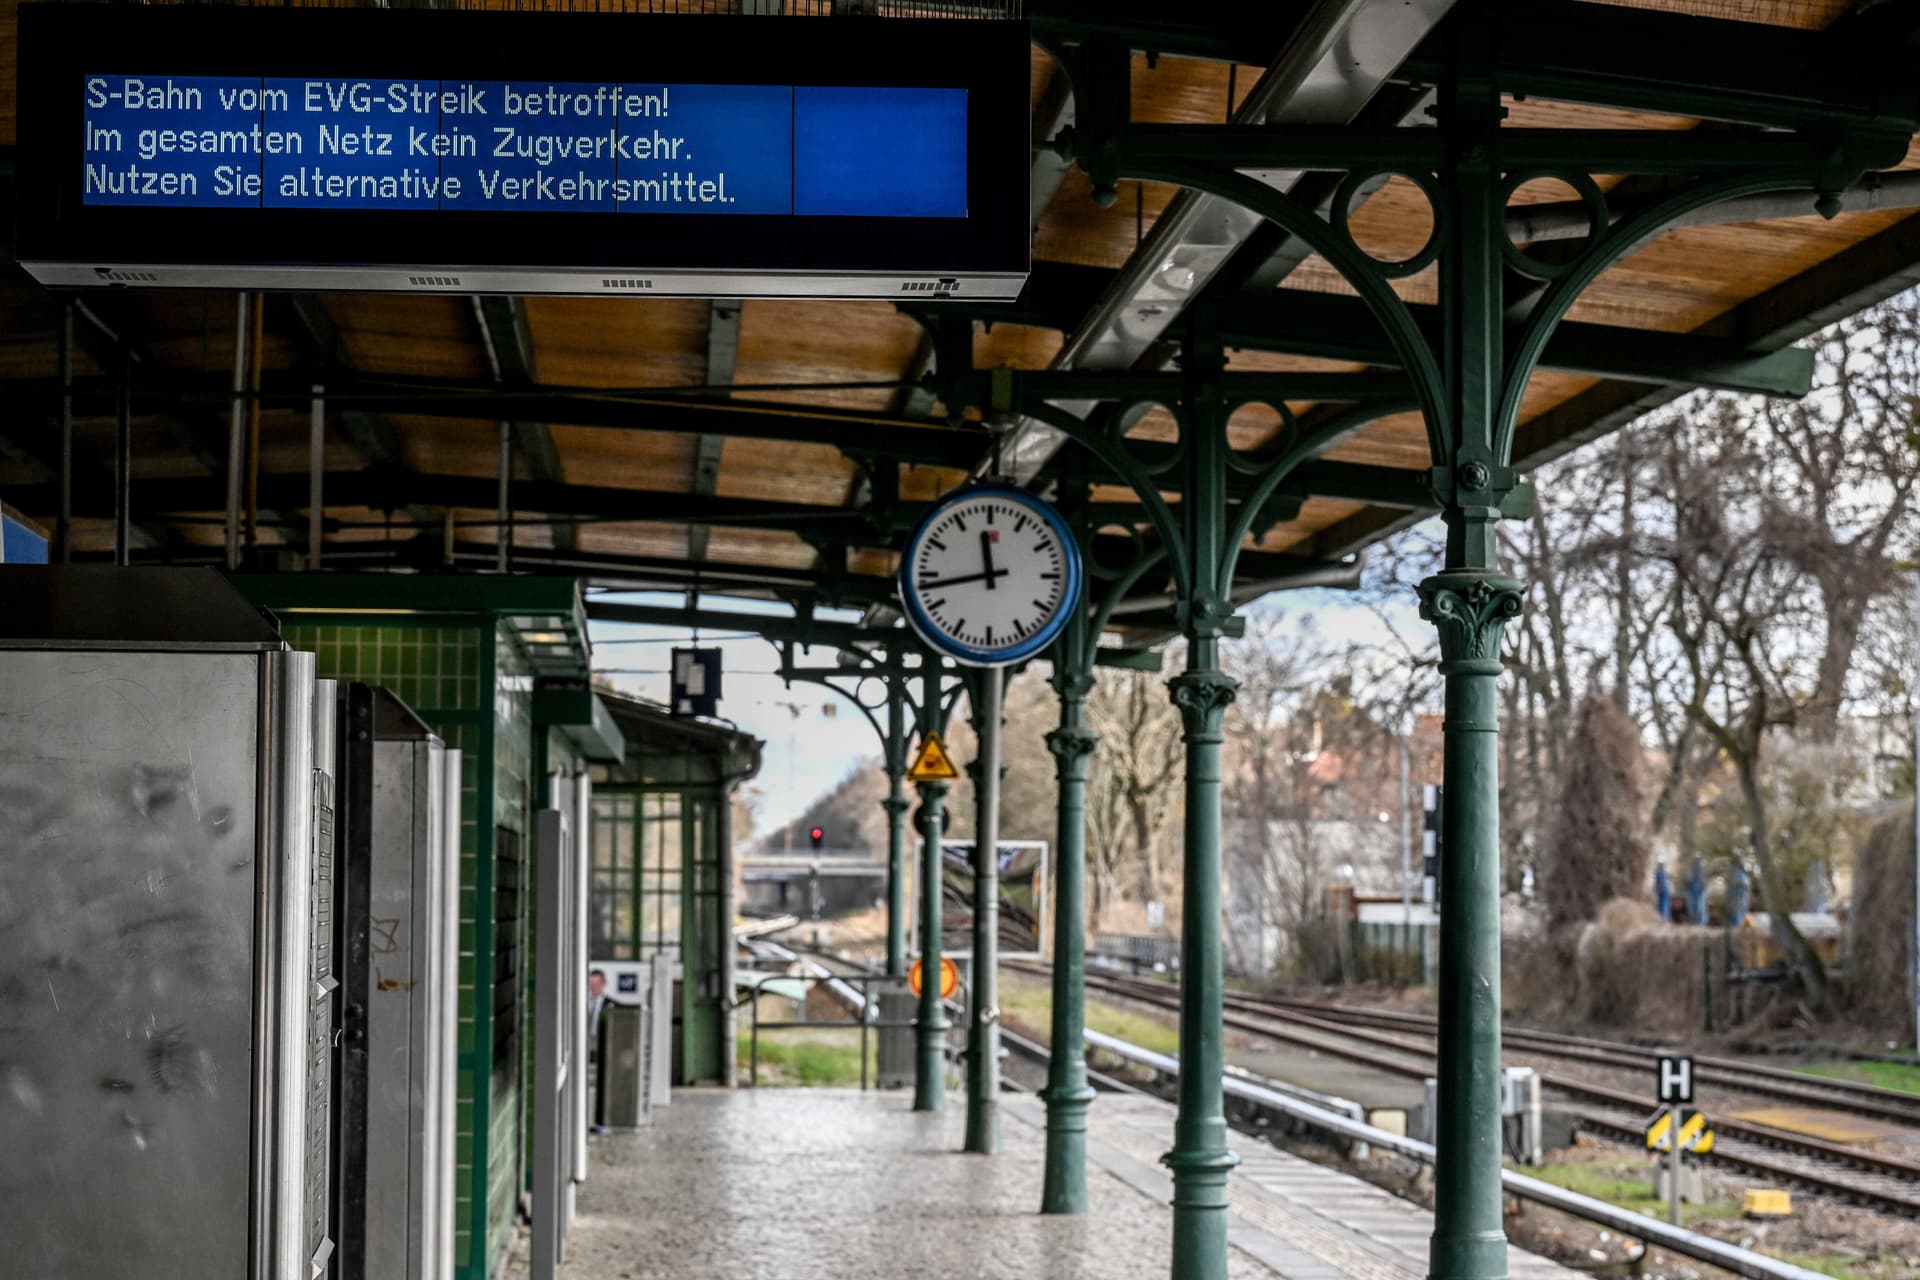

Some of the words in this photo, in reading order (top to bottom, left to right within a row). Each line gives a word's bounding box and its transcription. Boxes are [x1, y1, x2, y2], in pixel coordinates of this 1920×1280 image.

[88, 78, 202, 110] S-Bahn
[219, 88, 288, 111] vom
[304, 81, 488, 114] EVG-Streik
[504, 85, 669, 117] betroffen!
[86, 120, 122, 152] Im
[138, 123, 302, 160] gesamten
[319, 124, 393, 156] Netz
[409, 126, 476, 157] kein
[493, 127, 692, 166] Zugverkehr.
[86, 163, 197, 195] Nutzen
[214, 165, 262, 196] Sie
[280, 166, 461, 199] alternative
[478, 169, 735, 203] Verkehrsmittel.
[1661, 1058, 1691, 1100] H
